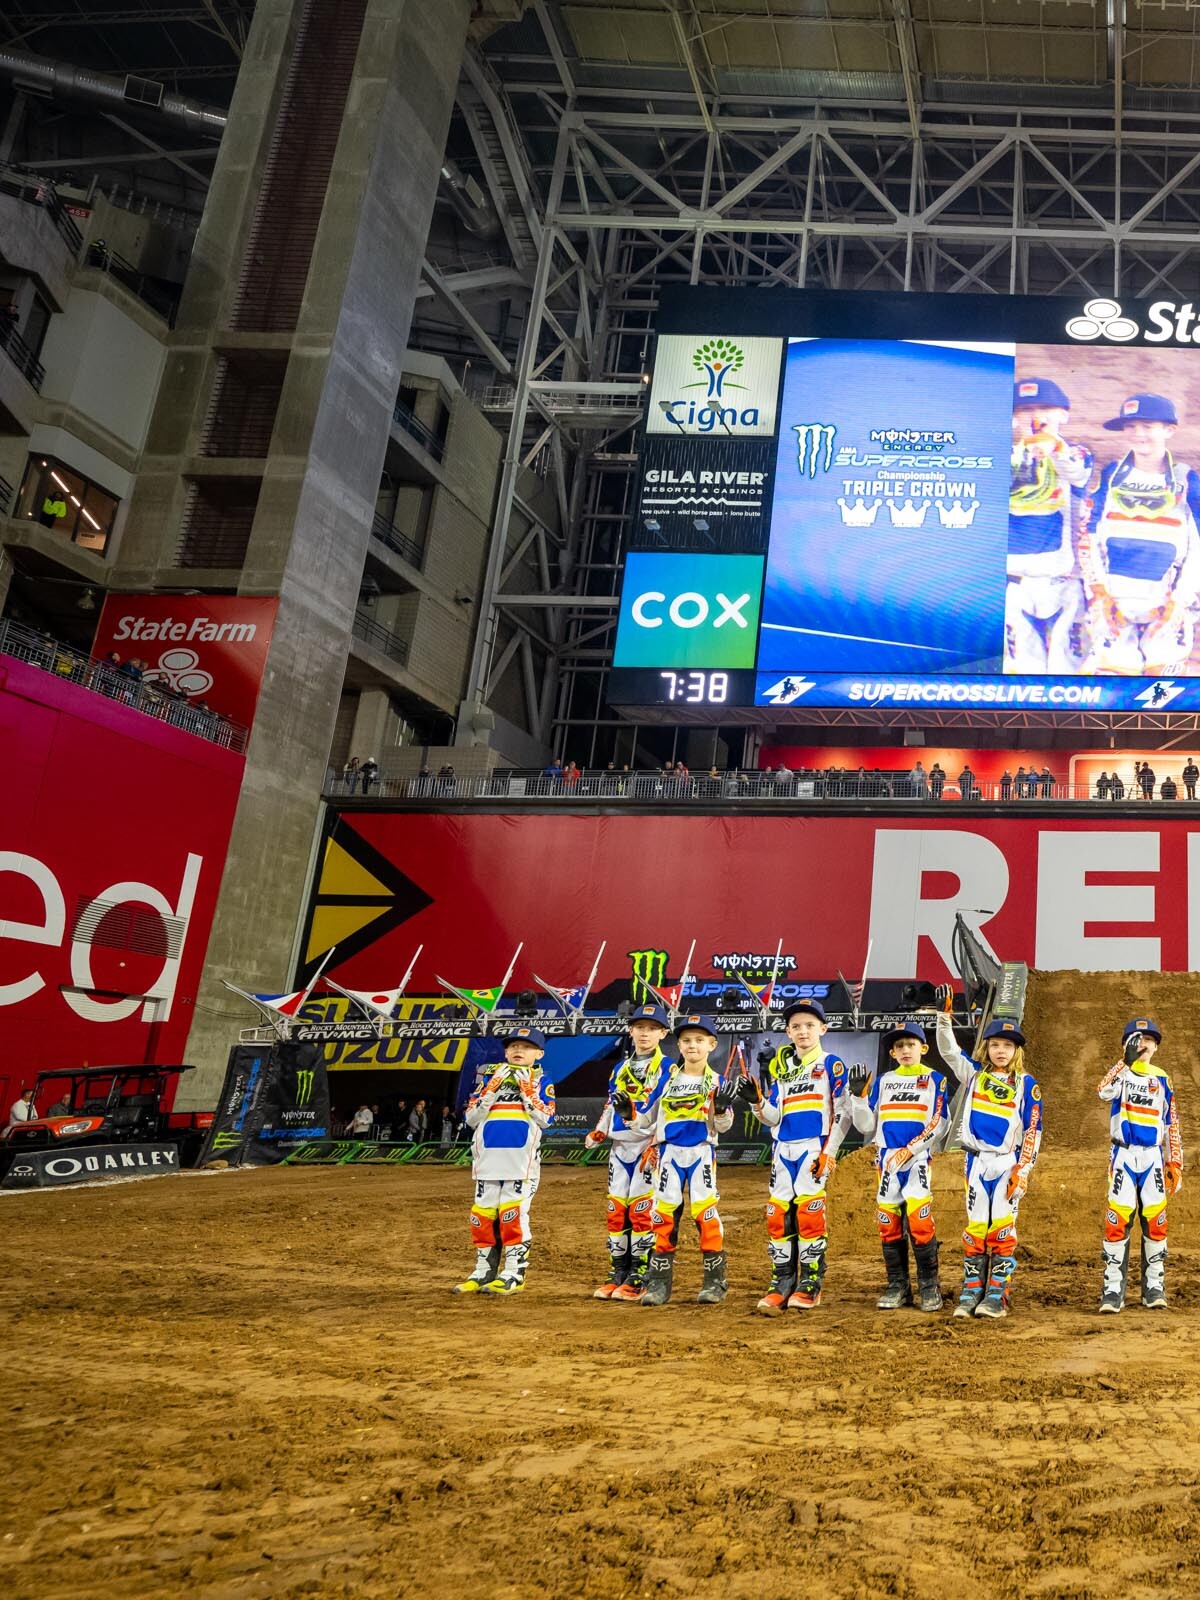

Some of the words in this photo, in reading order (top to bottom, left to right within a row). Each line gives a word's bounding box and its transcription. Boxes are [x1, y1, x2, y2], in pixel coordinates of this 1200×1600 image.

[665, 400, 759, 432] Cigna
[871, 429, 956, 444] MONSTER
[834, 454, 993, 469] SUPERCROSS
[645, 469, 696, 484] GILA
[700, 471, 765, 486] RIVER
[877, 470, 946, 482] Championship
[643, 486, 697, 494] RESORTS
[842, 480, 905, 497] TRIPLE
[910, 481, 976, 498] CROWN
[632, 591, 751, 629] COX
[660, 672, 729, 702] 7:38
[848, 683, 1103, 704] SUPERCROSSLIVE.COM
[713, 953, 798, 969] MONSTER
[334, 1023, 372, 1031] MOUNTAIN
[324, 1038, 462, 1064] UZUKI
[670, 1084, 688, 1093] TROY
[788, 1082, 814, 1096] KTM
[884, 1082, 902, 1090] TROY
[903, 1082, 916, 1090] LEE
[889, 1091, 921, 1102] KTM
[1127, 1093, 1153, 1107] KTM
[281, 1111, 316, 1121] MONSTER
[85, 1151, 175, 1171] OAKLEY
[659, 1166, 668, 1193] KTM
[703, 1164, 713, 1189] KTM
[879, 1170, 891, 1197] KTM
[918, 1164, 929, 1190] KTM
[1112, 1168, 1124, 1196] KTM
[1154, 1167, 1164, 1194] KTM
[968, 1184, 977, 1212] KTM
